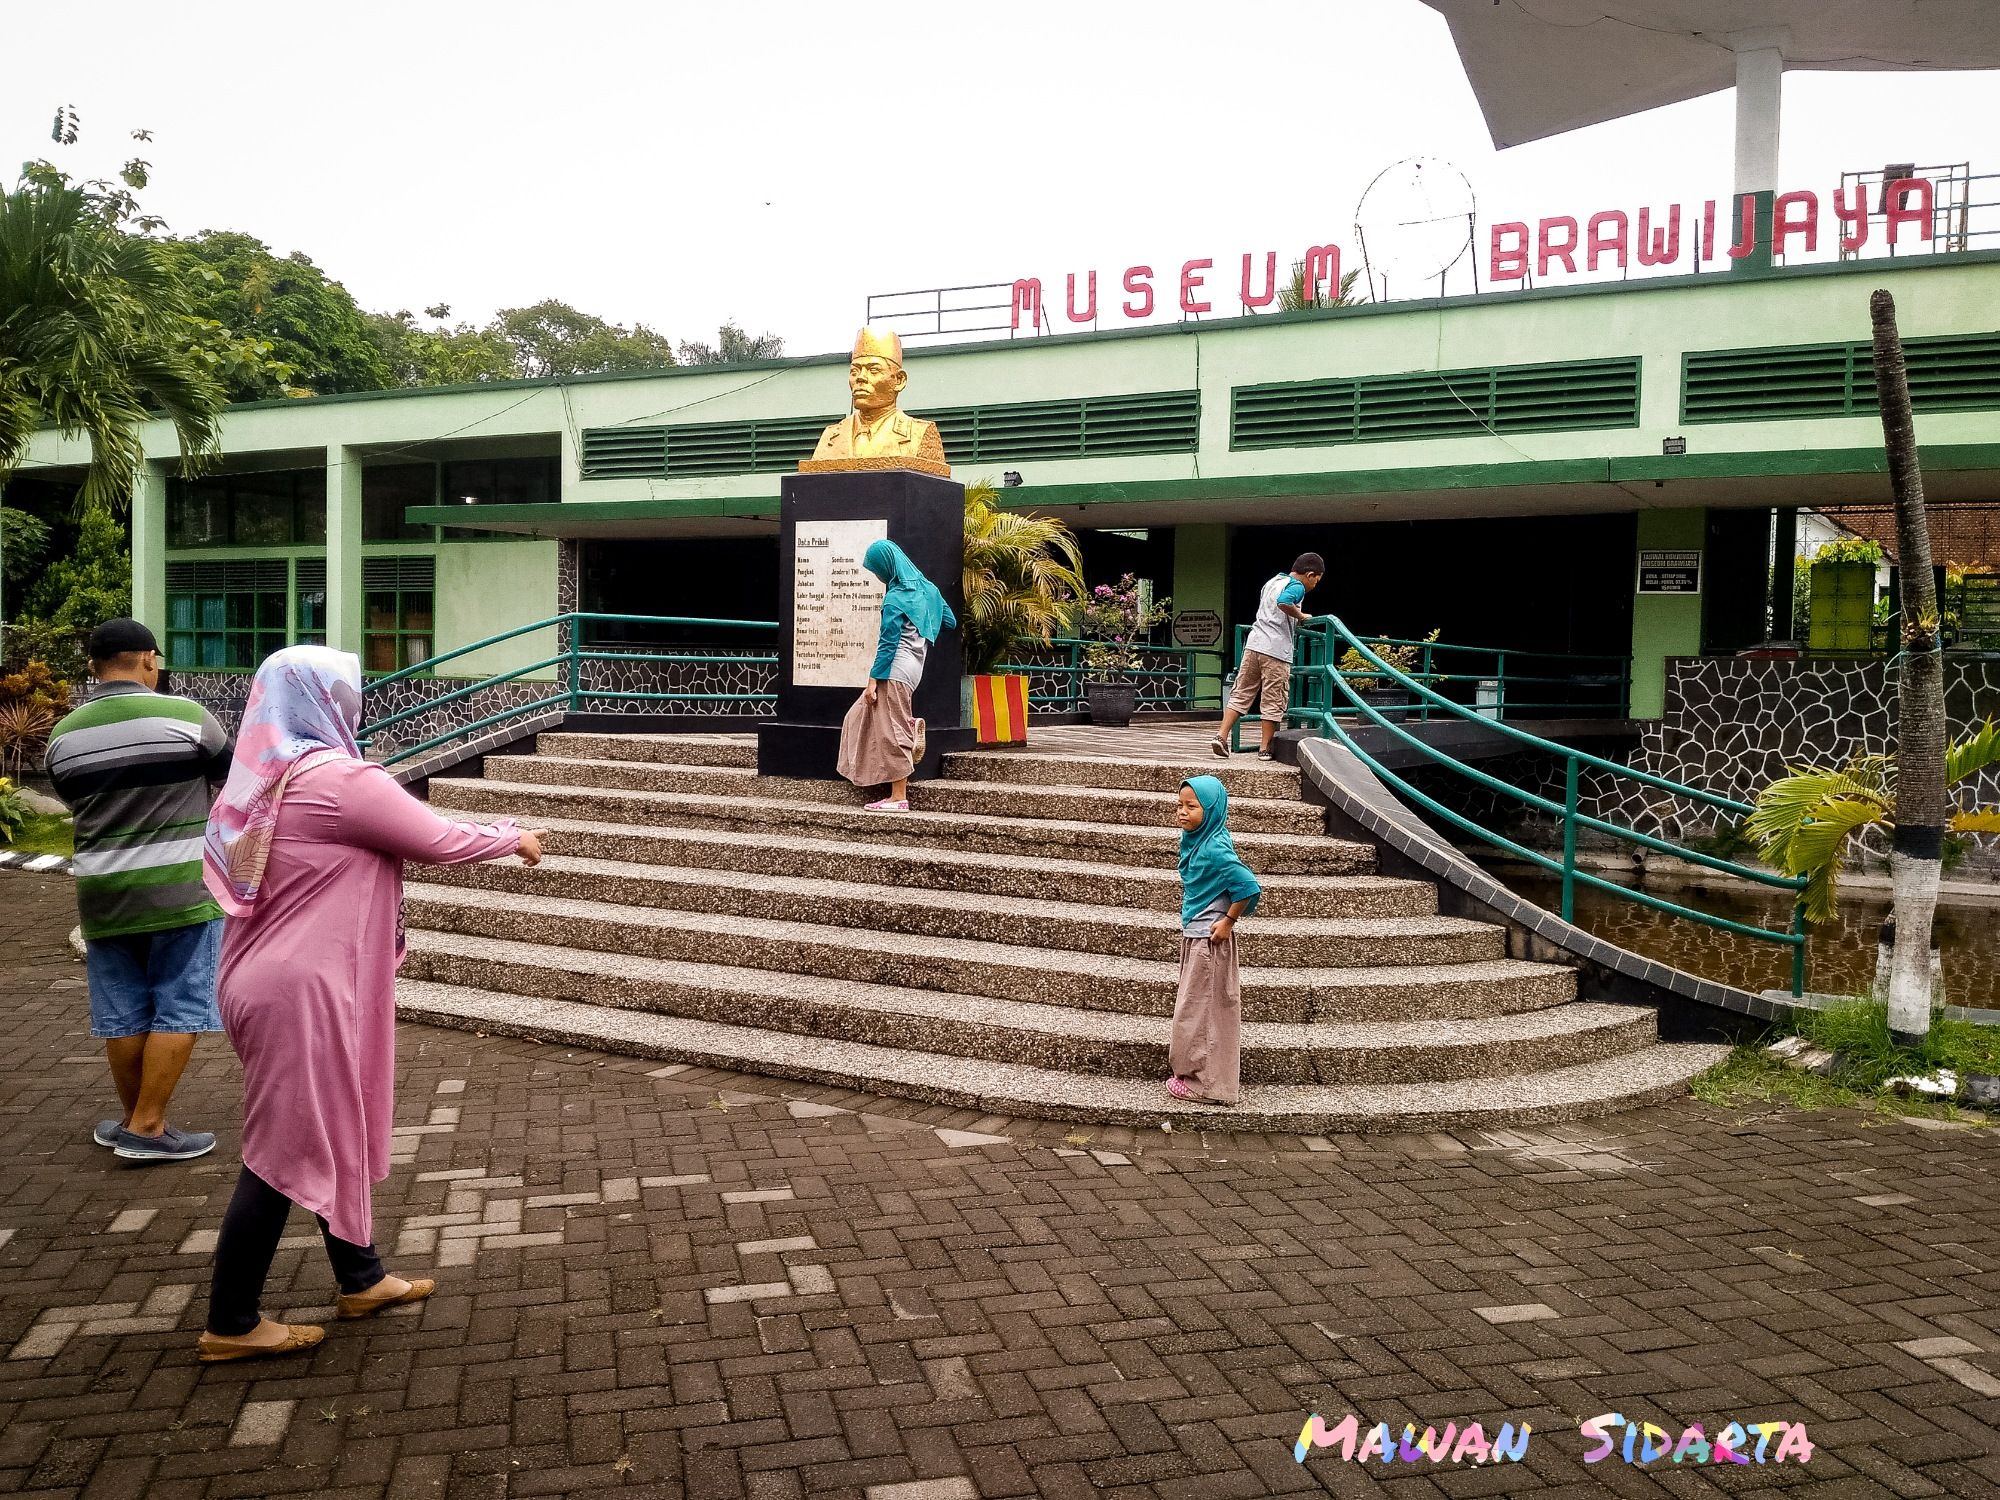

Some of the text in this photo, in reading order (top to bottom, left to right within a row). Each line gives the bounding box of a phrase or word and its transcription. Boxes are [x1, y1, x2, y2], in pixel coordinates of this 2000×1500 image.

[1011, 178, 1934, 329] MUSEUM BRAWIJAYA
[811, 537, 829, 546] Pribadi
